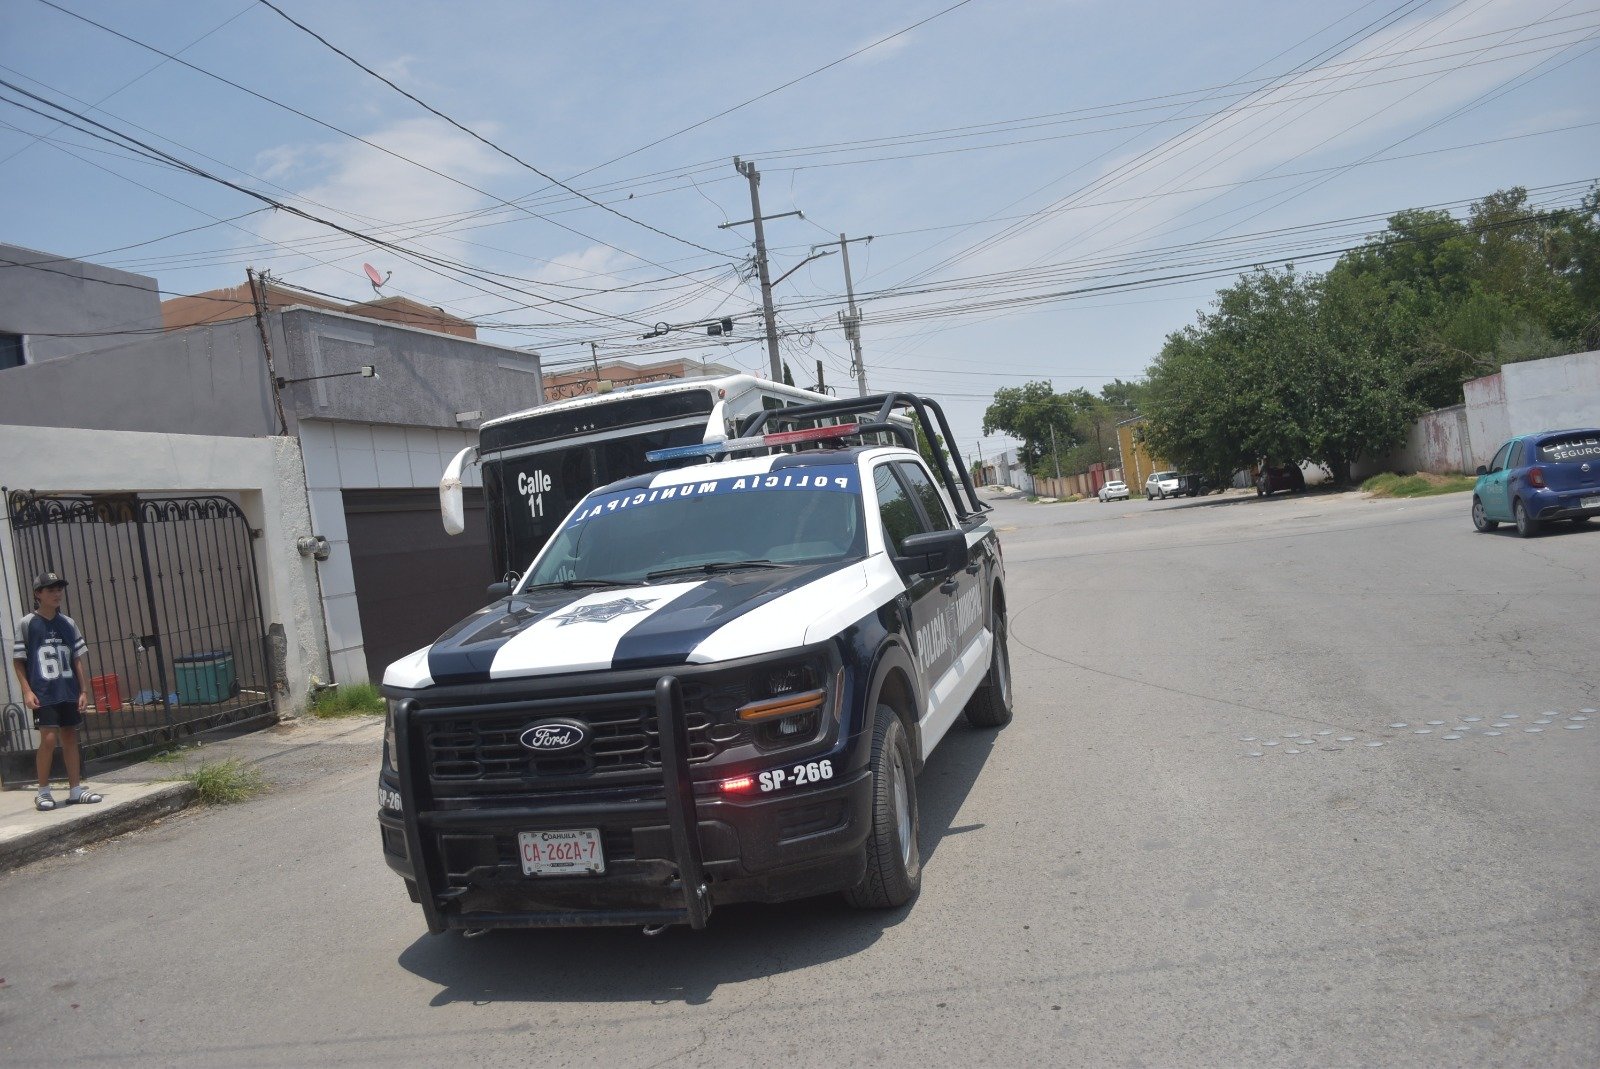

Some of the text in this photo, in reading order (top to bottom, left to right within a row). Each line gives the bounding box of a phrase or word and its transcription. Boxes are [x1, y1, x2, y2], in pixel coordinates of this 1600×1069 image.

[1553, 446, 1600, 460] SEGURO
[517, 469, 552, 495] Calle
[528, 493, 544, 517] 11
[532, 728, 571, 747] Ford
[758, 759, 834, 792] SP-266
[379, 788, 403, 811] SP-26
[541, 832, 577, 841] COAHUILA
[523, 841, 596, 862] CA-262A-7
